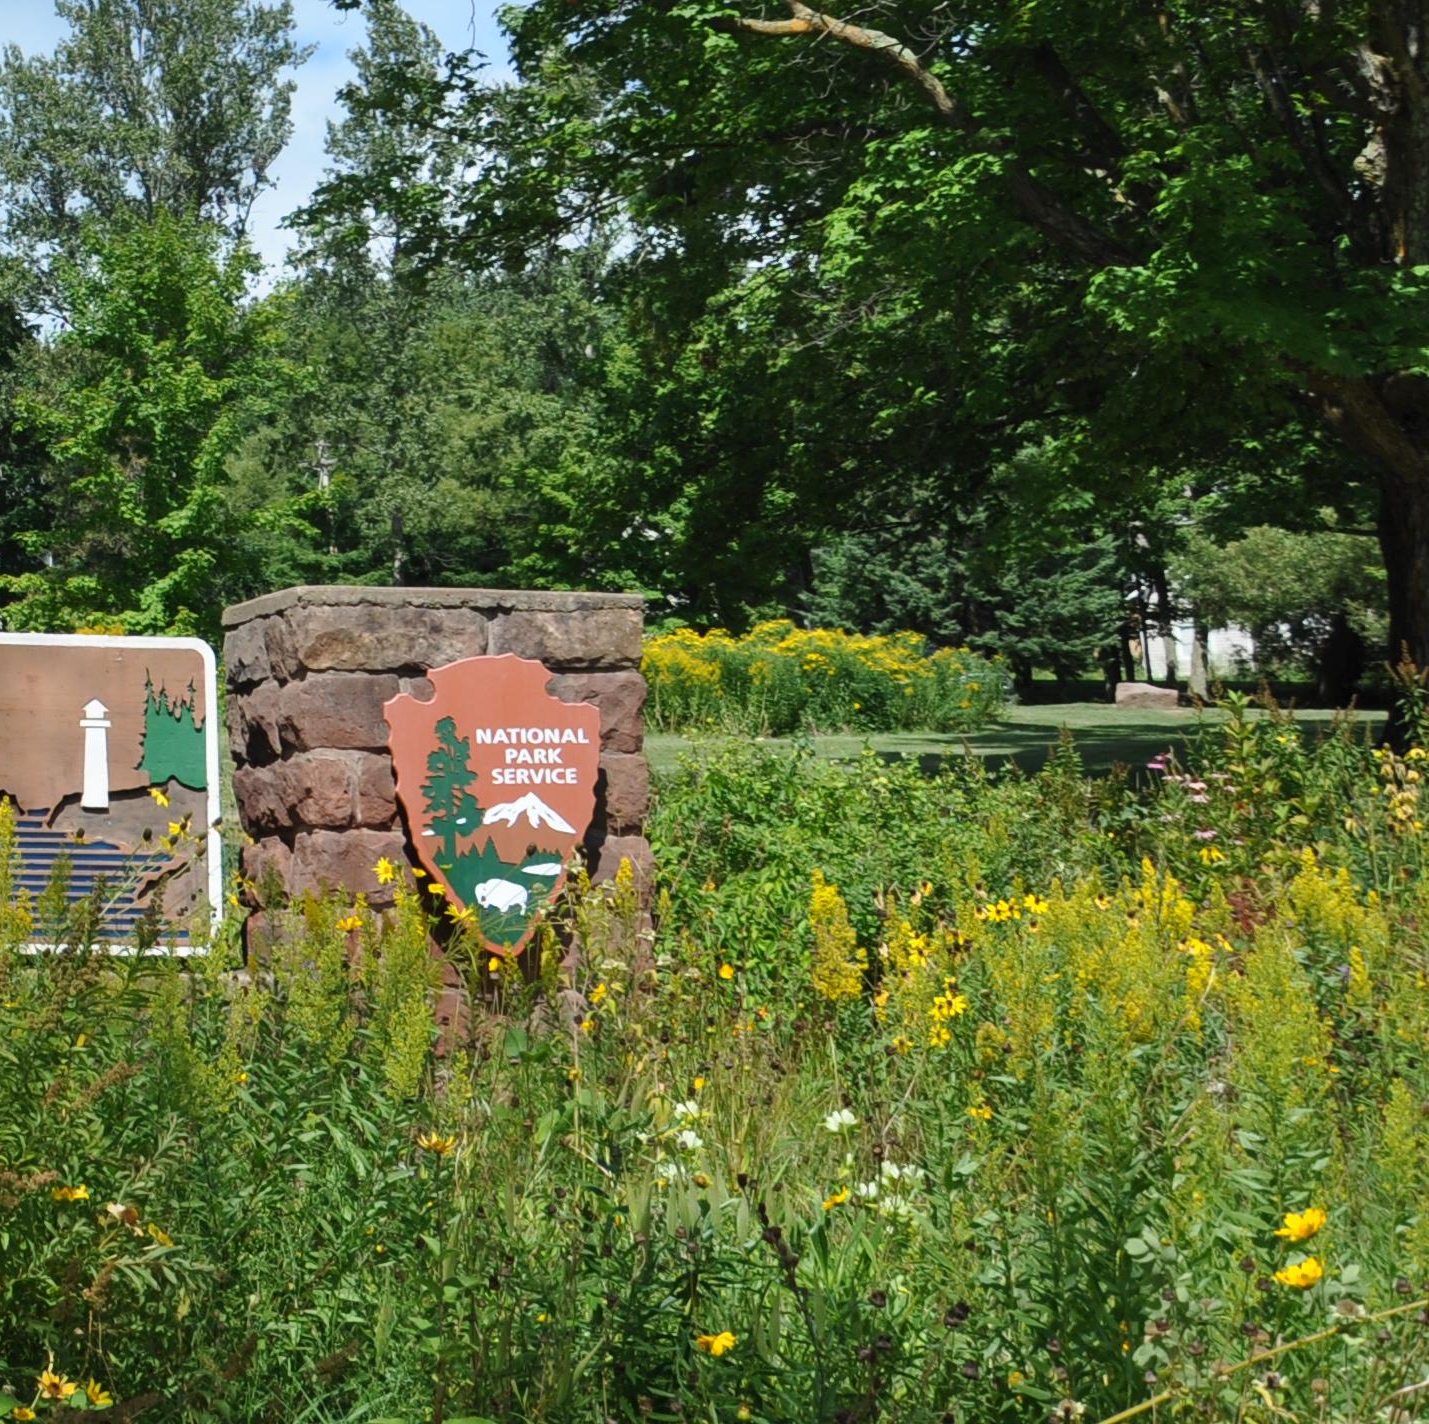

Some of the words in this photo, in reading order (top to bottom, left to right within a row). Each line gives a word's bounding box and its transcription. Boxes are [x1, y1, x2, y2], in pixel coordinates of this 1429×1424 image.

[475, 727, 590, 745] NATIONAL
[504, 747, 564, 765] PARK
[490, 767, 579, 785] SERVICE
